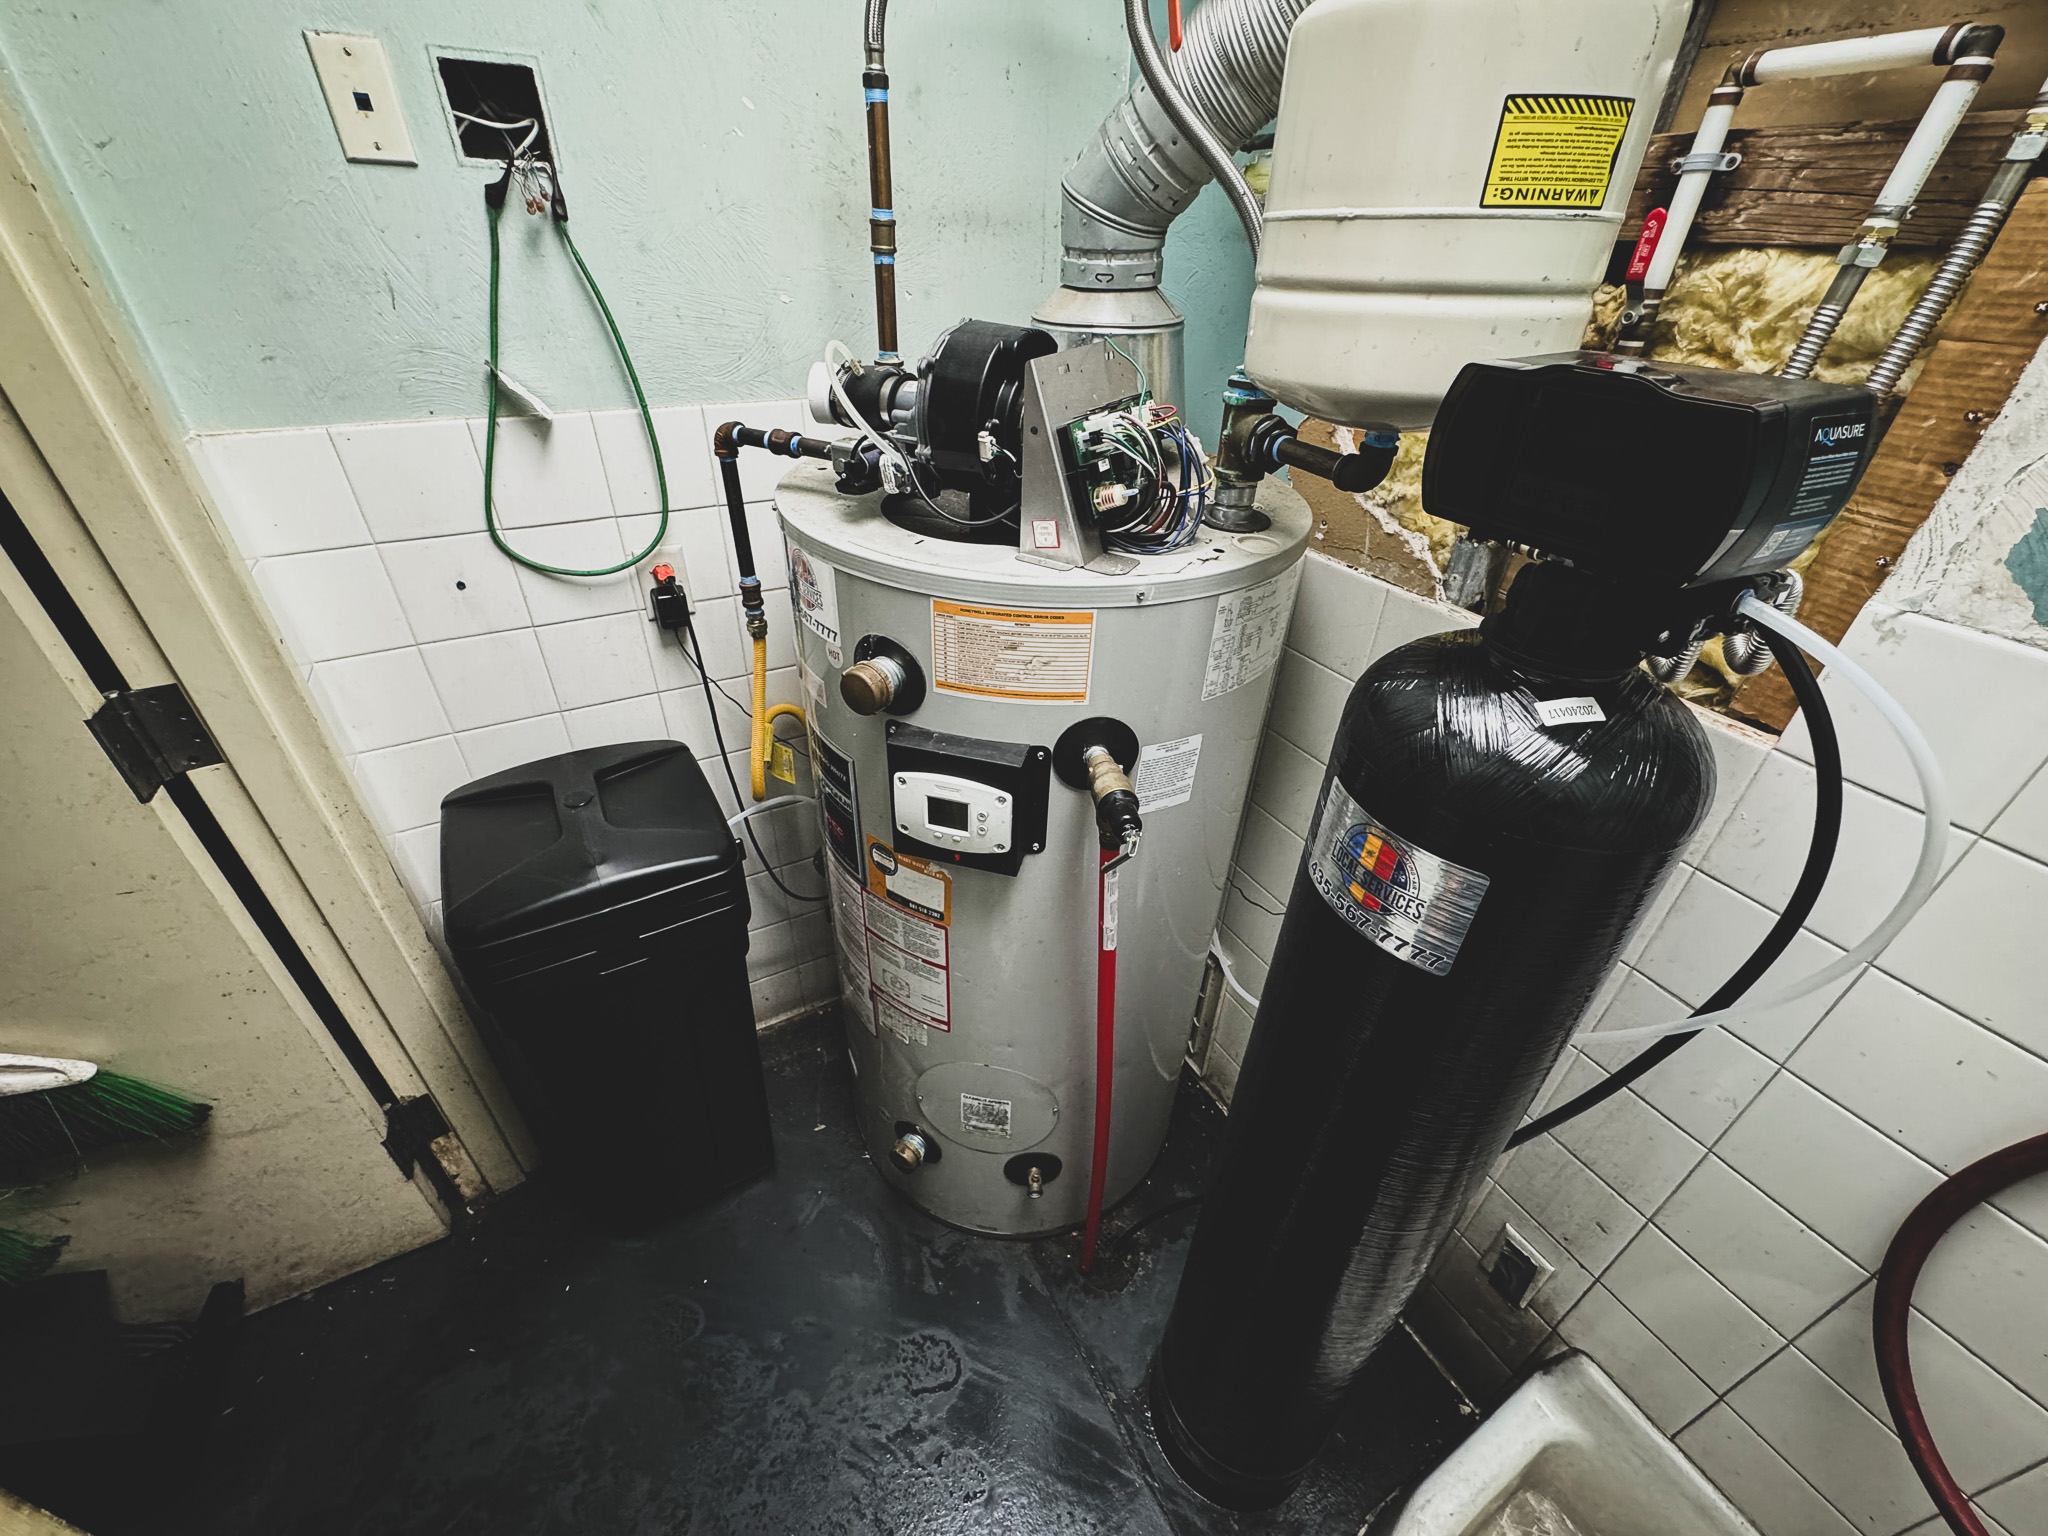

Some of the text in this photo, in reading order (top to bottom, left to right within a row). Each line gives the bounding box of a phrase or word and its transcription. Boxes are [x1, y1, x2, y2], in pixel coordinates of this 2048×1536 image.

[1493, 188, 1586, 202] WARNING:
[1814, 423, 1866, 447] AQUASURE
[986, 610, 1012, 618] INTEGRATED
[828, 647, 840, 662] HOT
[1332, 839, 1427, 920] LOCAL SERVICES
[1310, 861, 1447, 969] 435-567-7777
